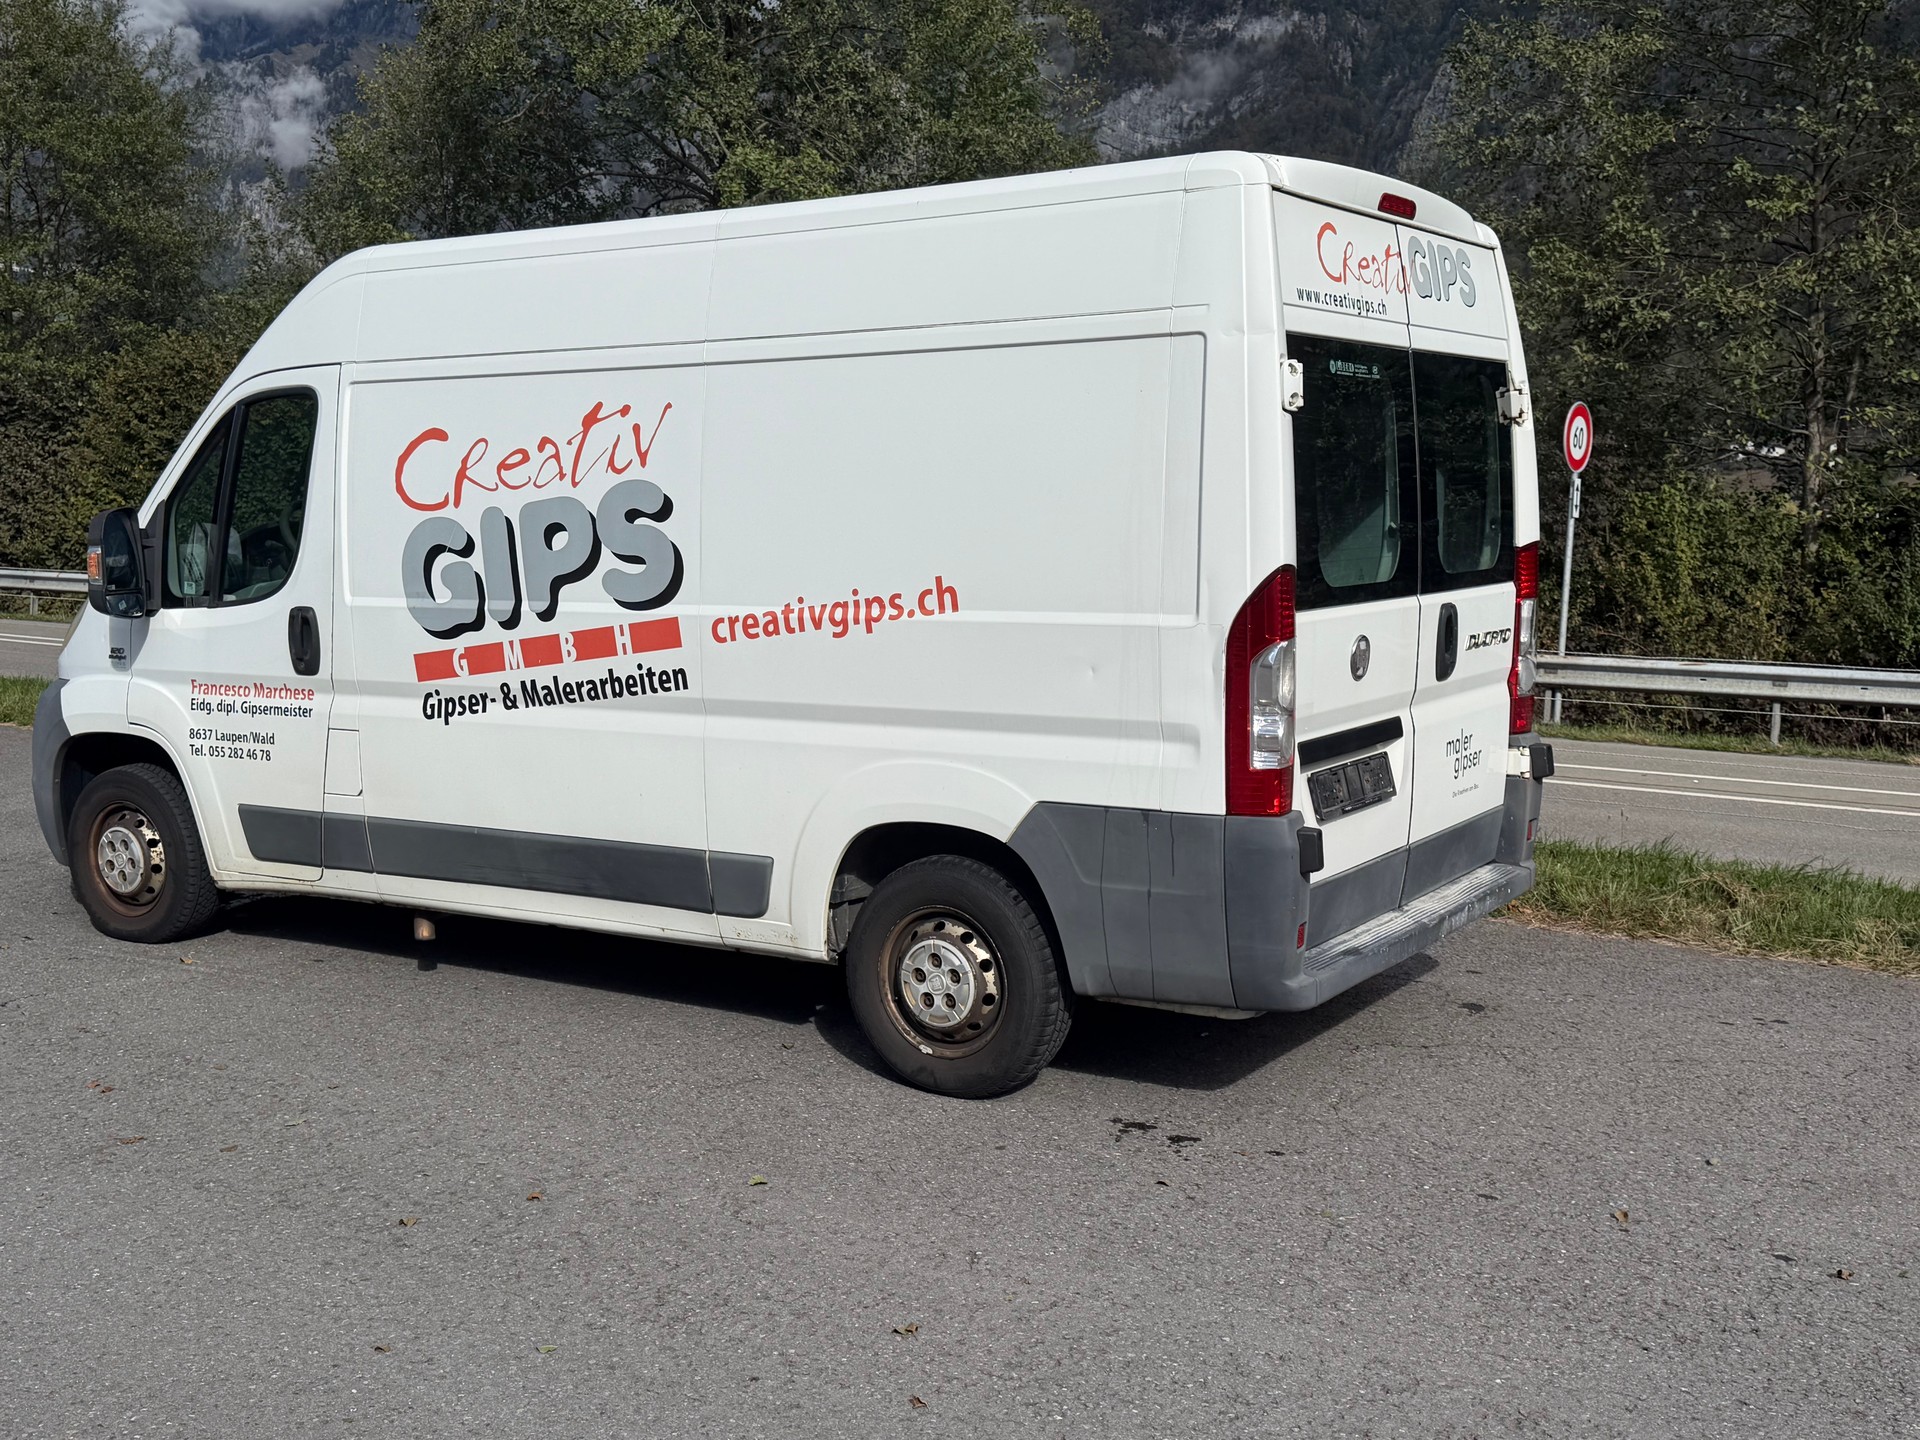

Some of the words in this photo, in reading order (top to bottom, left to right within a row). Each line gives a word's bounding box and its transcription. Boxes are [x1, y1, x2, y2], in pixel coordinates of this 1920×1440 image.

[1317, 222, 1415, 295] Creativ
[1408, 235, 1476, 308] GIPS
[1296, 287, 1388, 316] www.creativgips.ch
[1573, 426, 1584, 450] 60
[394, 401, 673, 512] Creativ
[401, 479, 684, 640] GIPS
[711, 575, 959, 644] creativgips.ch
[191, 679, 251, 698] Francesco
[253, 682, 315, 701] Marchese
[422, 689, 497, 726] Gipser-
[501, 682, 520, 711] &
[520, 662, 689, 709] Malerarbeiten
[190, 698, 215, 716] Eidg.
[216, 699, 239, 717] dipl.
[240, 701, 314, 719] Gipsermeister
[189, 728, 213, 741] 8637
[215, 729, 275, 746] Laupen/Wald
[1446, 728, 1473, 757] maler
[189, 744, 207, 757] Tel.
[208, 746, 226, 758] 055
[228, 747, 245, 760] 282
[246, 749, 258, 761] 46
[259, 750, 272, 762] 78
